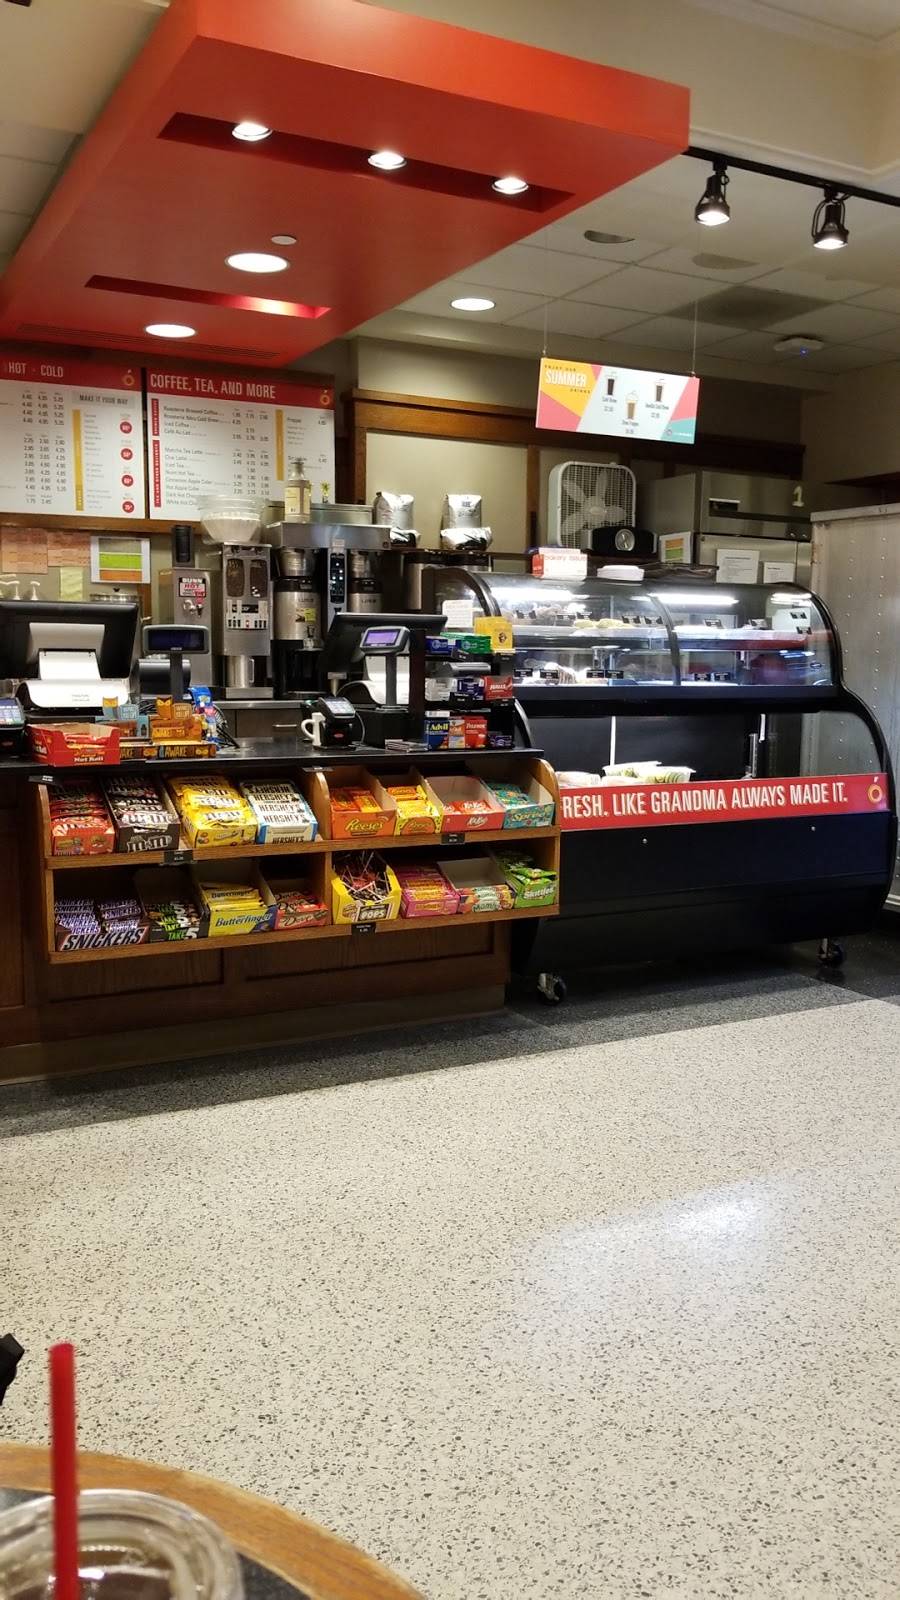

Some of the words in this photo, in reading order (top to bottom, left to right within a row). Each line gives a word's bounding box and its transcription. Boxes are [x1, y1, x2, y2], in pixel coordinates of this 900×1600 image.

[8, 362, 26, 374] HOT
[40, 365, 64, 377] COLD
[150, 373, 192, 391] COFFEE,
[221, 381, 243, 395] AND
[246, 384, 276, 399] MORE
[546, 369, 587, 387] SUMMER
[792, 485, 804, 507] 1
[430, 723, 448, 731] Advil
[165, 745, 187, 757] AWAKE
[612, 792, 647, 816] LIKE
[650, 787, 728, 814] GRANDMA
[731, 784, 785, 809] ALWAYS
[789, 783, 830, 806] MADE
[832, 781, 849, 803] IT.
[215, 912, 273, 928] Butterfinger
[361, 911, 386, 920] POPS
[62, 927, 146, 951] SNICKERS
[168, 932, 186, 940] TAKE
[184, 927, 200, 940] 5
